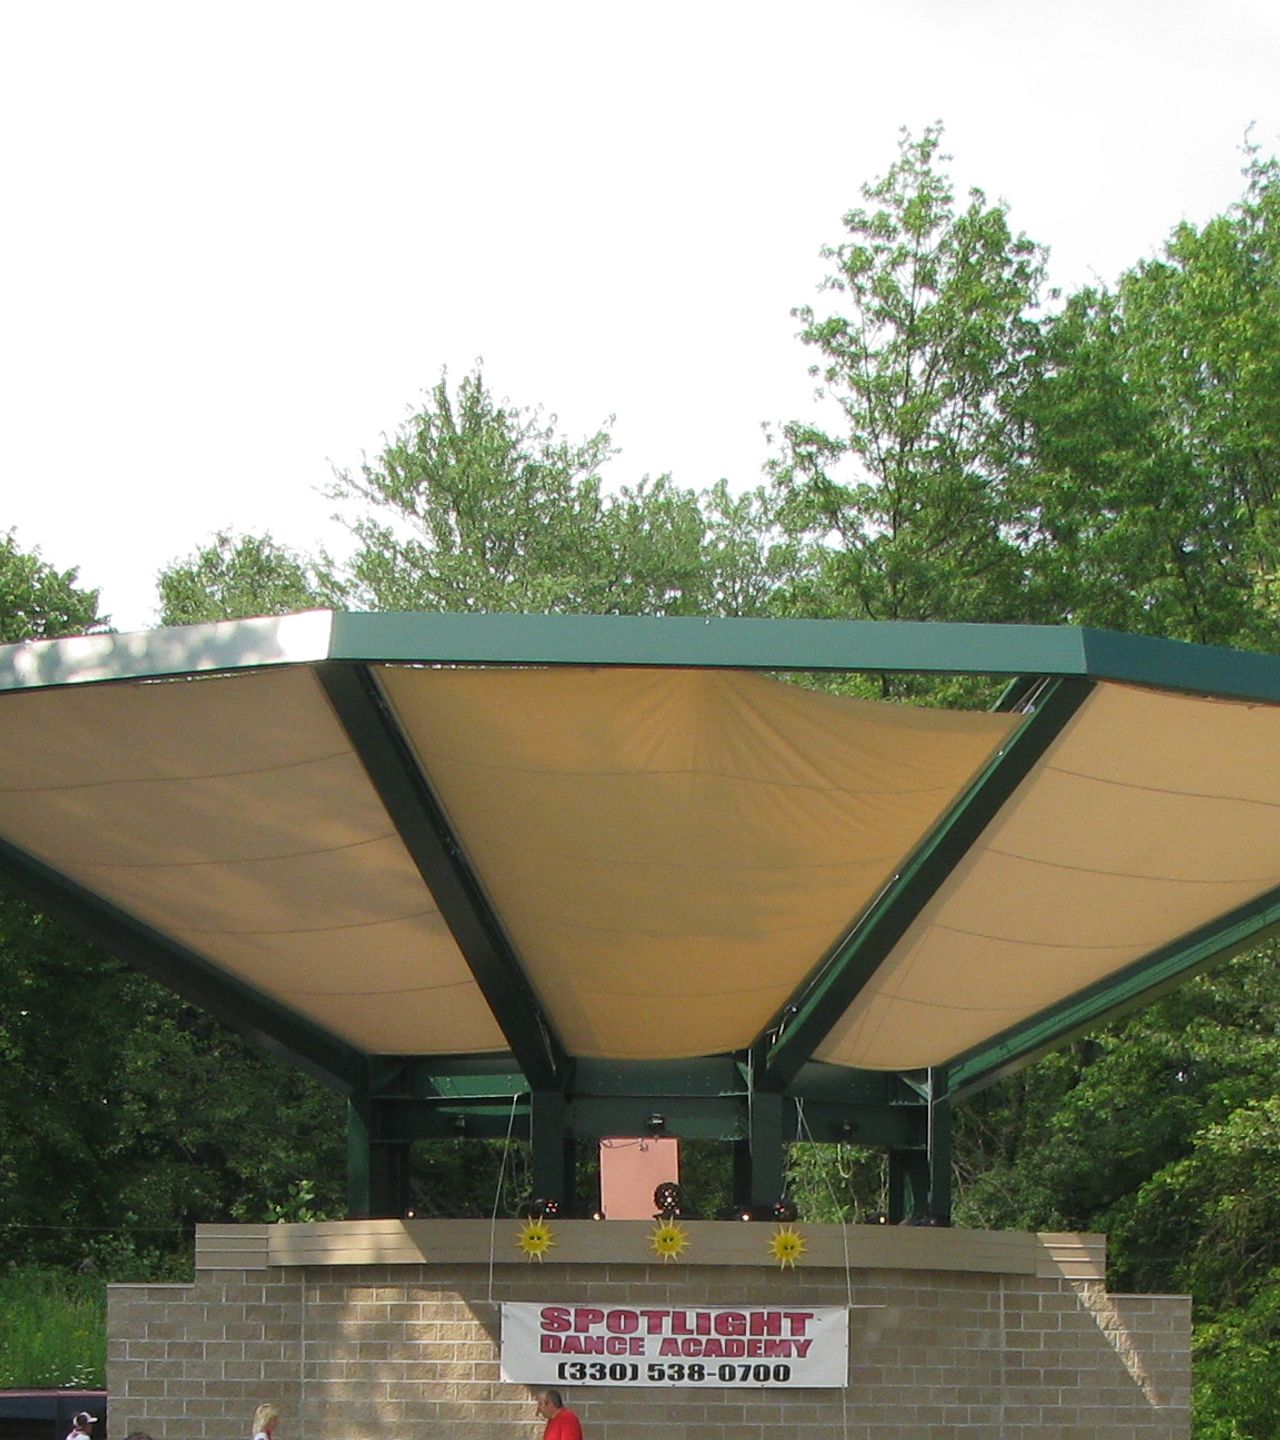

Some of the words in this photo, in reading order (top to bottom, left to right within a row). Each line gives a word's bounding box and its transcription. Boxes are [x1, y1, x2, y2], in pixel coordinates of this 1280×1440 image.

[540, 1307, 814, 1337] SPOTLIGHT
[540, 1334, 646, 1357] DANCE
[658, 1336, 814, 1359] ACADEMY
[557, 1362, 639, 1382] (330)
[647, 1363, 791, 1383] 538-0700
